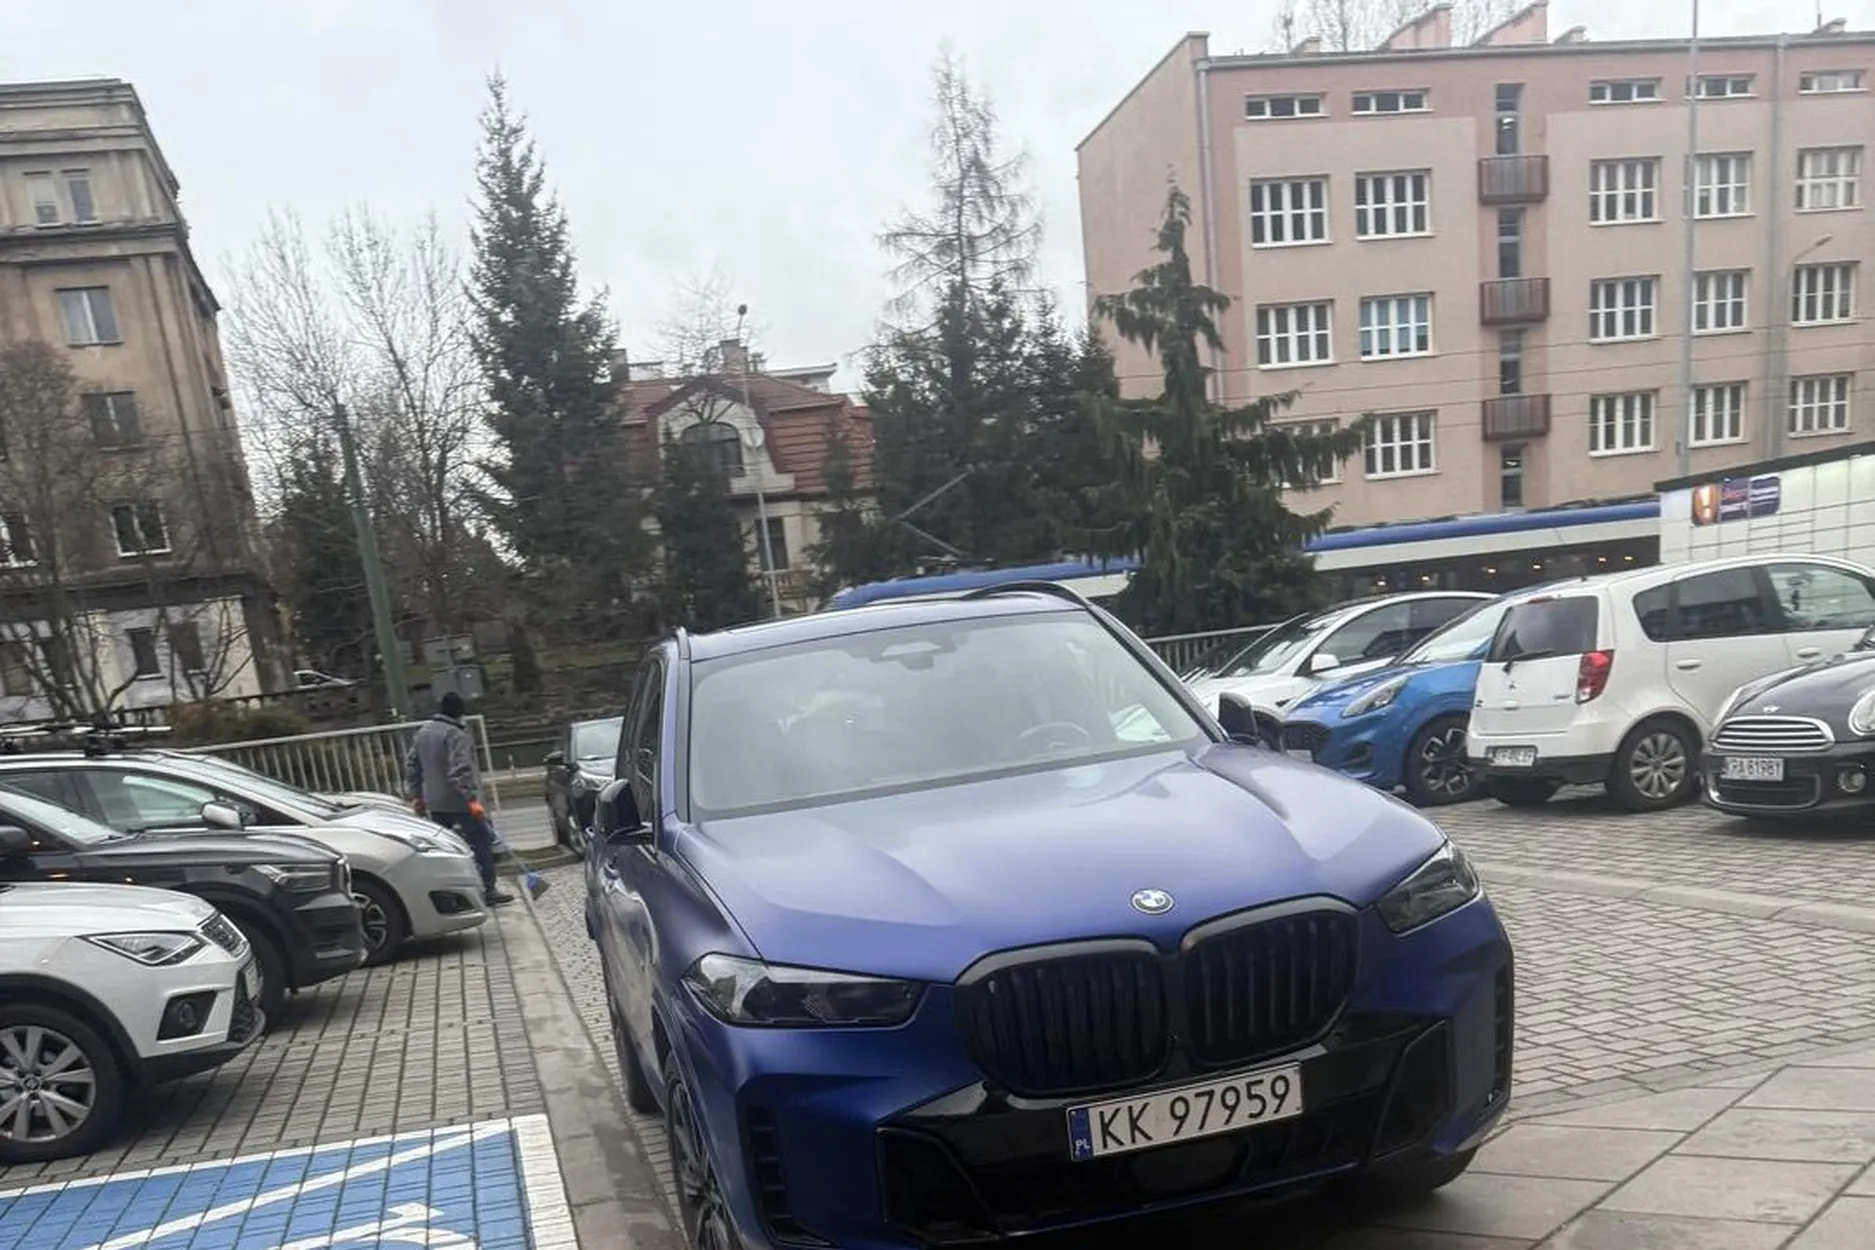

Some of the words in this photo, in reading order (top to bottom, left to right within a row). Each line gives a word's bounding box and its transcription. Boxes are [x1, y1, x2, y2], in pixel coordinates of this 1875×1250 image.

[1099, 1102, 1153, 1149] KK
[1169, 1074, 1290, 1136] 97959
[1075, 1138, 1091, 1151] PL
